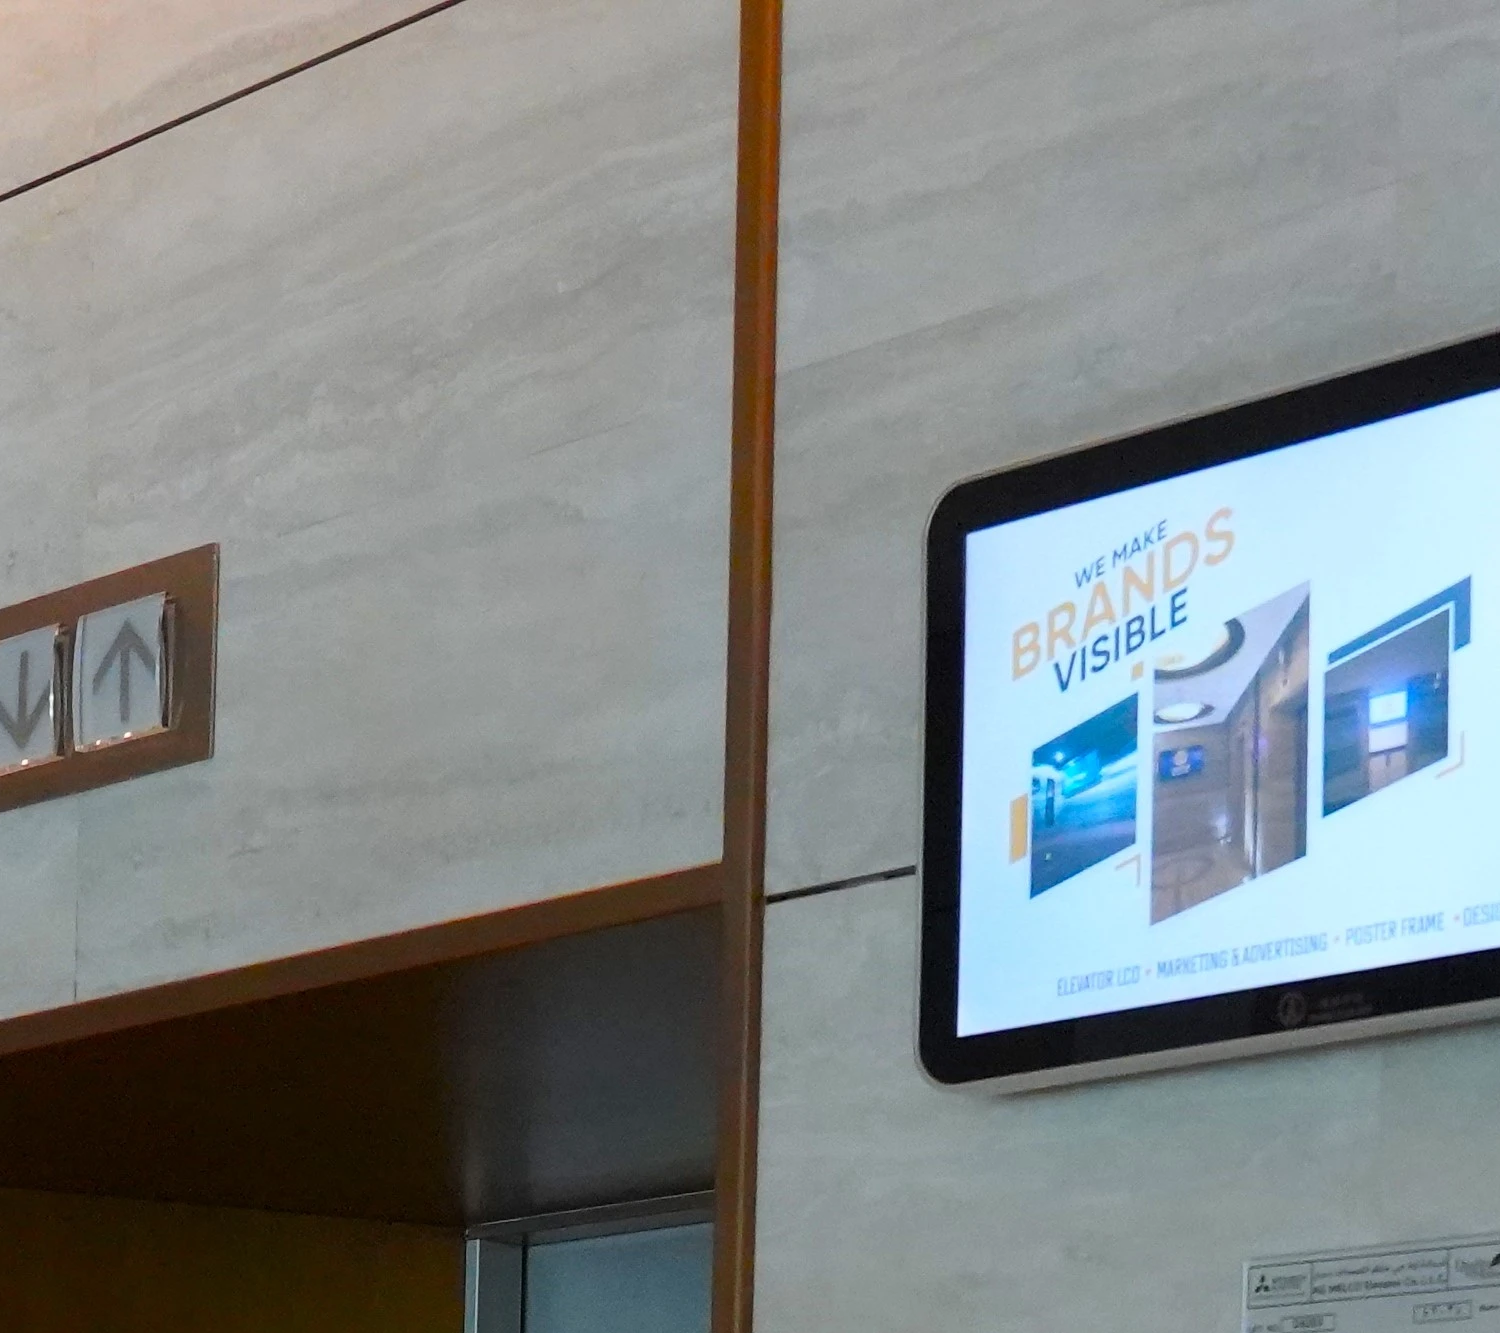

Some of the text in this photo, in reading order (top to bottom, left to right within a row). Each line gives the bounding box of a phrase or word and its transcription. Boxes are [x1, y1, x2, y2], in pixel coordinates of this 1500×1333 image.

[1012, 506, 1235, 682] BRANDS
[1074, 518, 1168, 588] WE MAKE
[1053, 587, 1188, 692] VISIBLE
[1057, 970, 1113, 996] ELEVATOR
[1156, 950, 1229, 979] MARKETING
[1242, 932, 1327, 963] ADVERTISING
[1345, 920, 1396, 946] POSTER
[1401, 911, 1445, 937] FRAME
